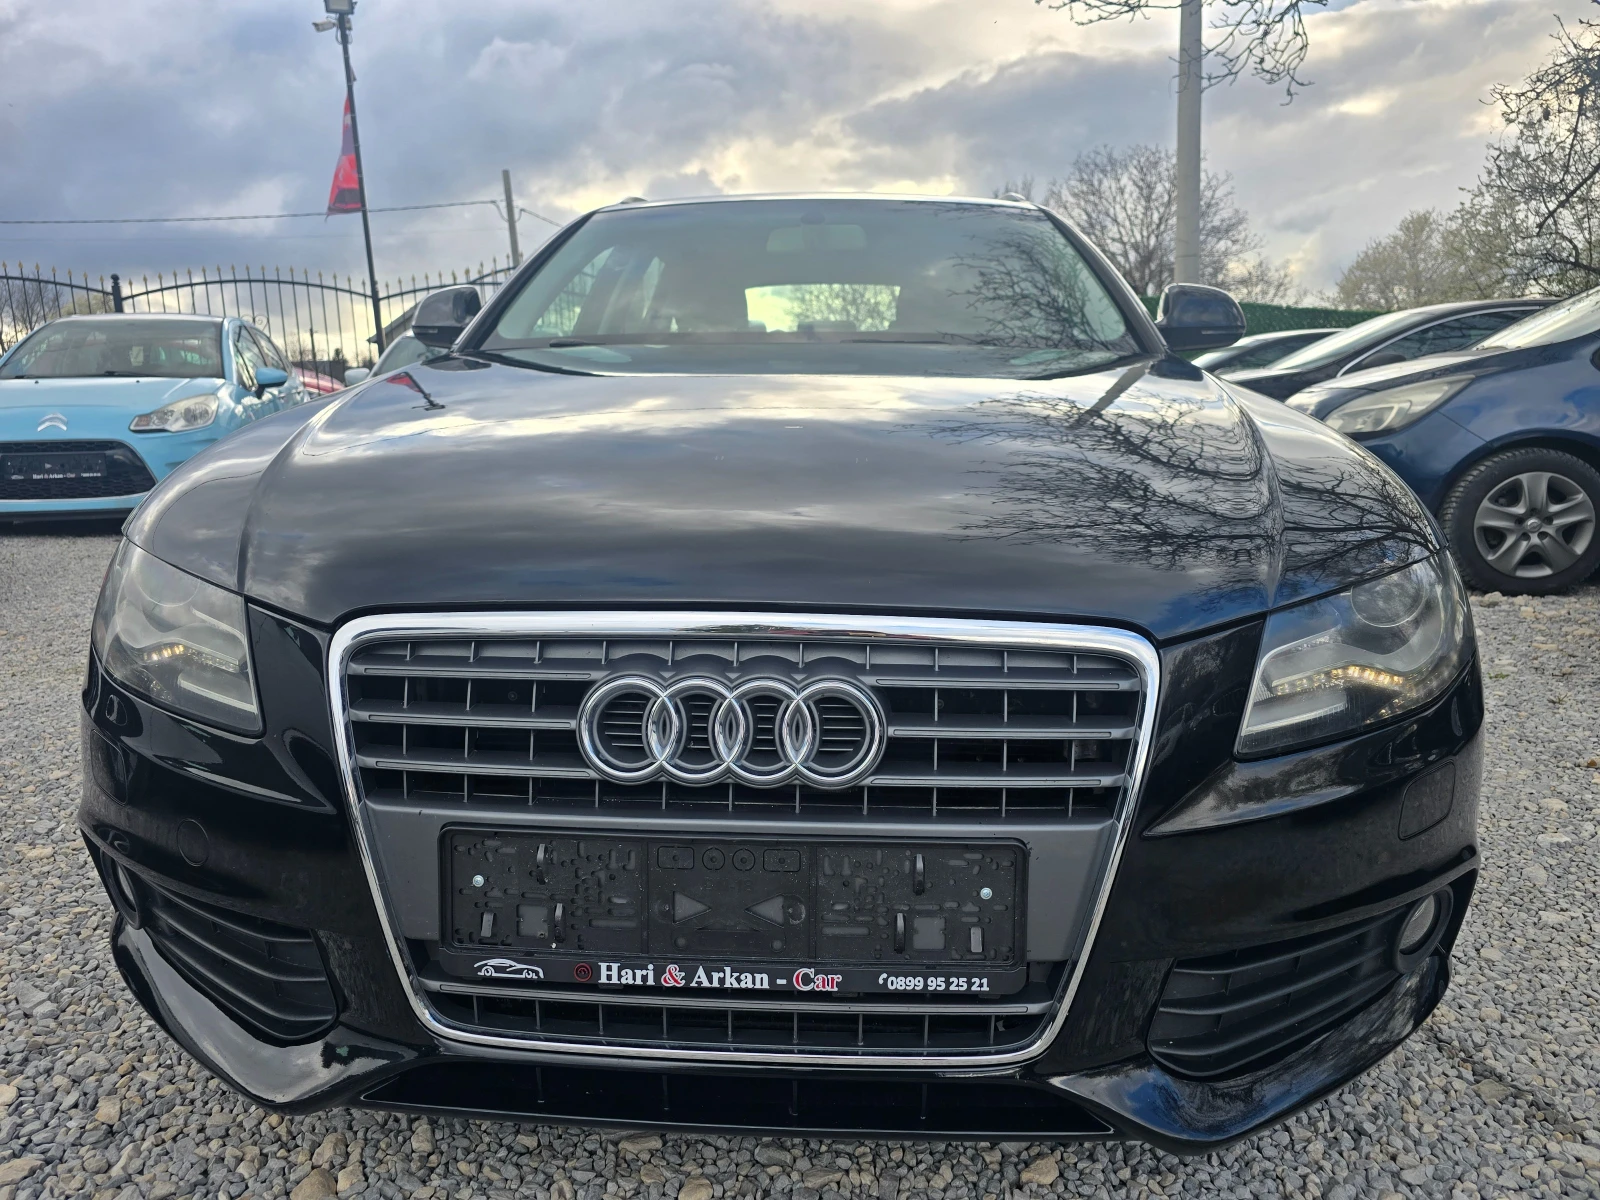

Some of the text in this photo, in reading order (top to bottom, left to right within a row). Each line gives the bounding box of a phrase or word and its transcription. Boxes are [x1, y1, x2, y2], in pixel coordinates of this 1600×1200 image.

[598, 963, 655, 986] Hari
[661, 964, 685, 987] &
[690, 965, 769, 989] Arkan
[793, 968, 842, 991] Car
[887, 976, 990, 991] 0899 95 25 21
